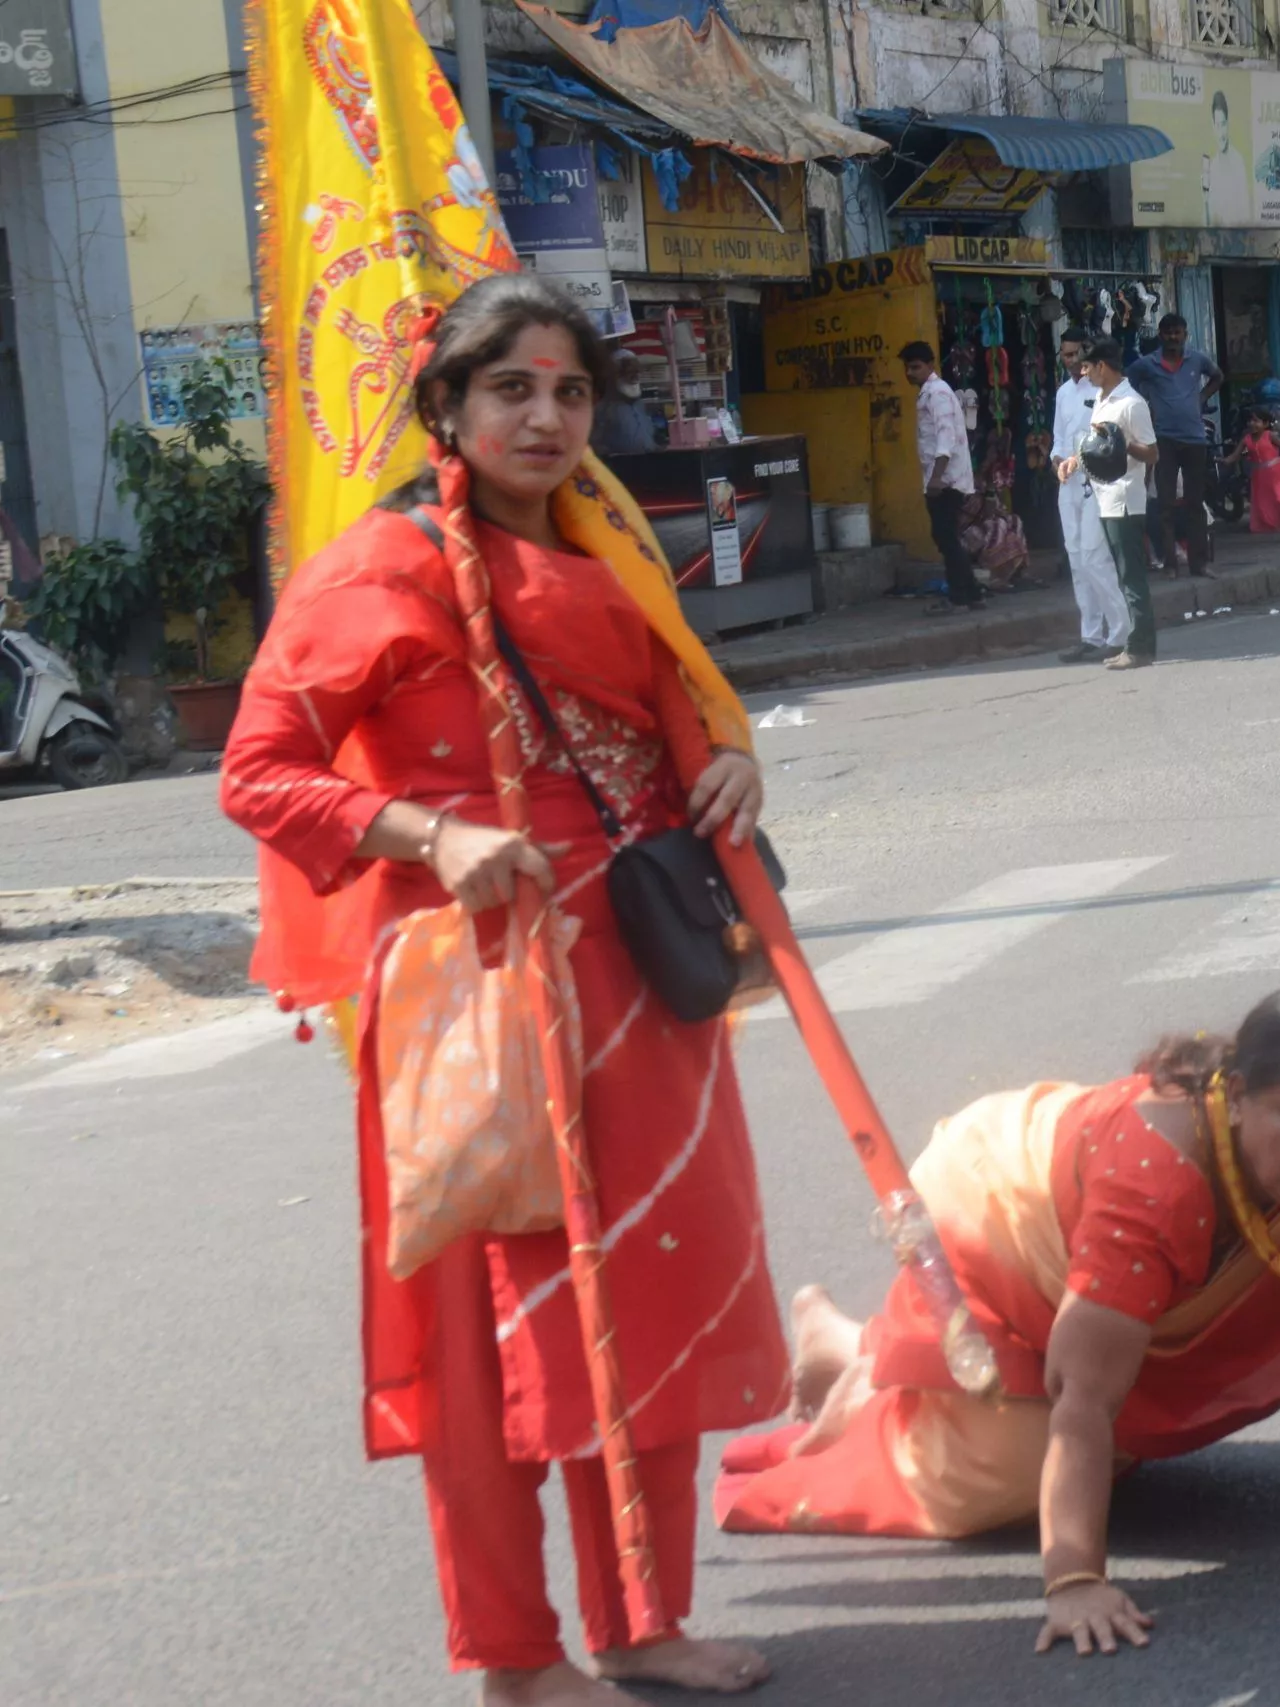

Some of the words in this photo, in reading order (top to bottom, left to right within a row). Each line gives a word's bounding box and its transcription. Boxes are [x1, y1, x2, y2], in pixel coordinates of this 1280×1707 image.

[662, 236, 704, 259] DAILY
[713, 235, 750, 260] HINDI
[954, 236, 979, 262] LID
[980, 239, 1010, 262] CAP
[835, 257, 894, 292] CAP
[853, 333, 890, 355] HYD.
